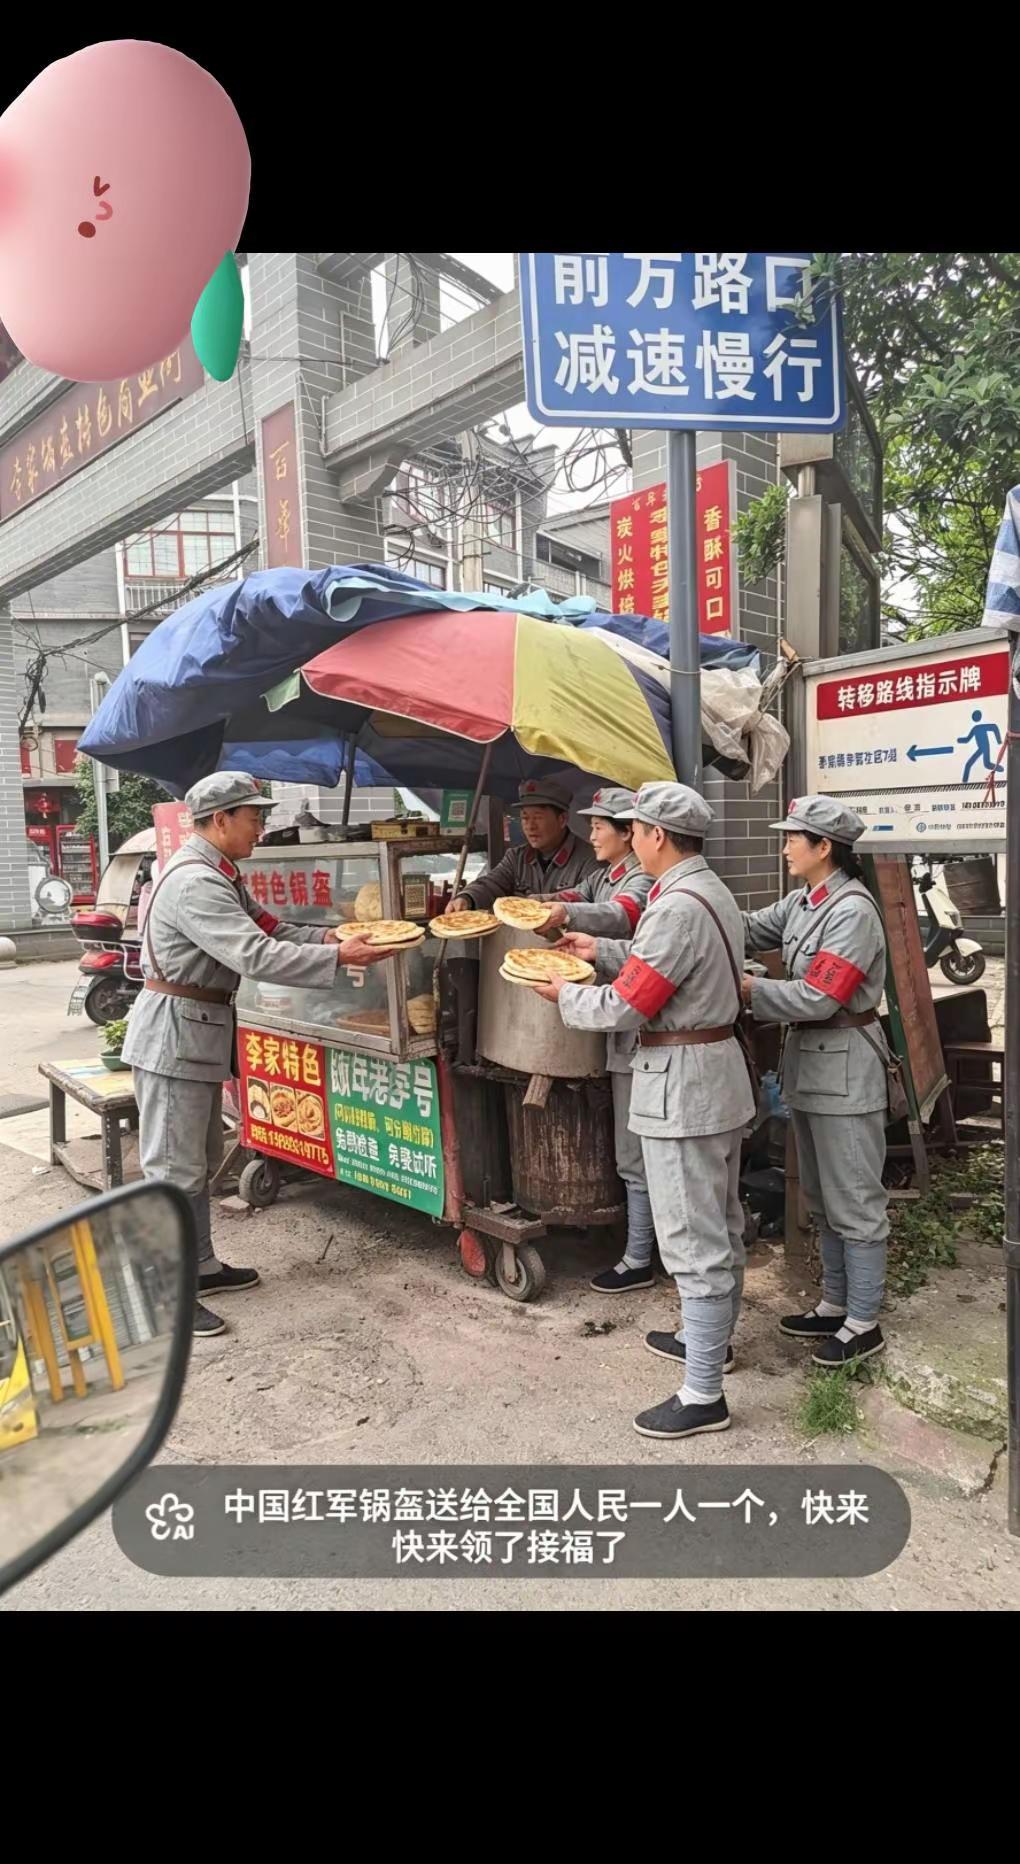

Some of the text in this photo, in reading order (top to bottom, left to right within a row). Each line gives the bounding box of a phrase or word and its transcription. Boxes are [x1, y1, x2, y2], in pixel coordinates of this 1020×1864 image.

[553, 252, 815, 315] 前方路口
[553, 323, 822, 403] 减速慢行
[703, 505, 725, 621] 香酥可口
[837, 664, 982, 712] 转移路线指示牌
[245, 1031, 322, 1087] 李家特色
